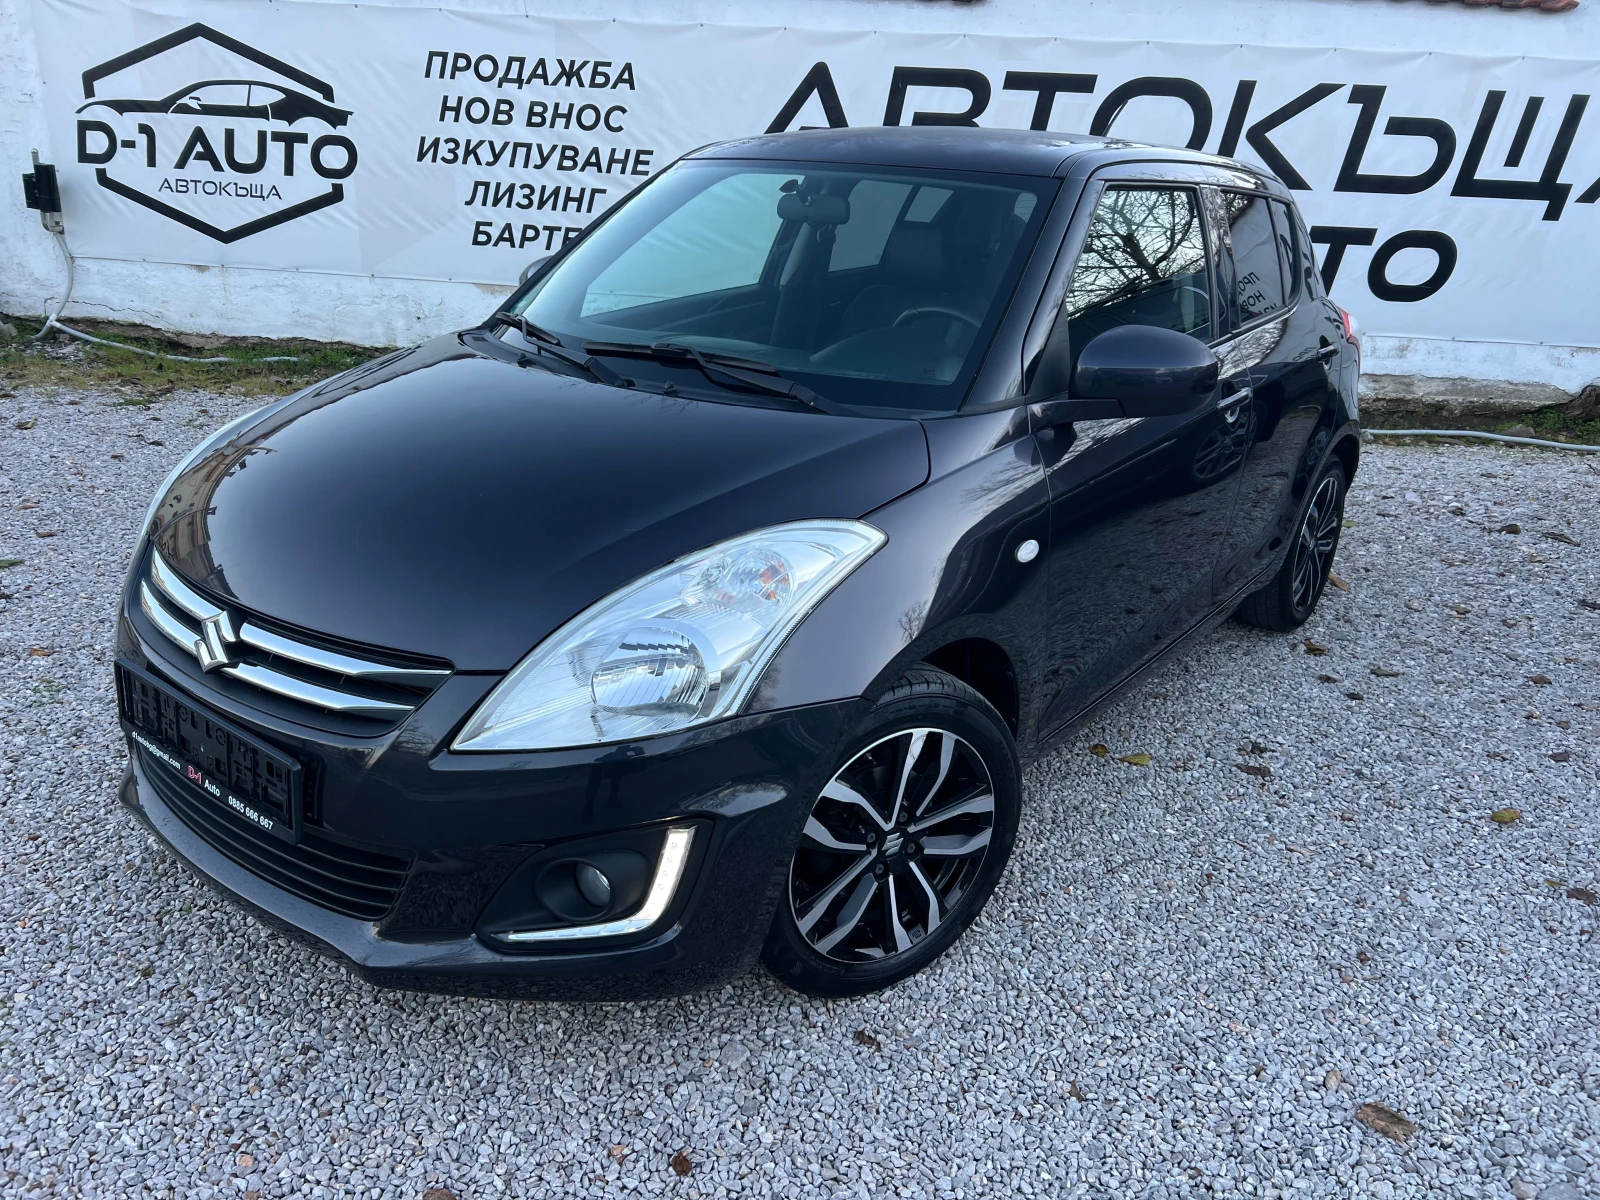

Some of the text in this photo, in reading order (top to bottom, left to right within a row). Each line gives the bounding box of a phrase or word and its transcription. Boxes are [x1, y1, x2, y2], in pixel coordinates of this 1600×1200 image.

[424, 50, 636, 91] ПРОДАЖБА
[438, 94, 628, 133] НОВ ВНОС
[76, 119, 358, 180] D-1 AUTO
[416, 135, 654, 178] ИЗКУПУВАНЕ
[763, 61, 1600, 222] АВТОКЪЩ
[158, 177, 283, 202] АВТОКЪЩА
[464, 180, 607, 214] ЛИЗИНГ
[471, 220, 585, 251] БАРТЕ
[187, 765, 202, 785] D-1
[204, 779, 220, 797] Auto
[228, 795, 245, 813] 0885
[245, 807, 259, 822] 666
[260, 816, 273, 830] 667
